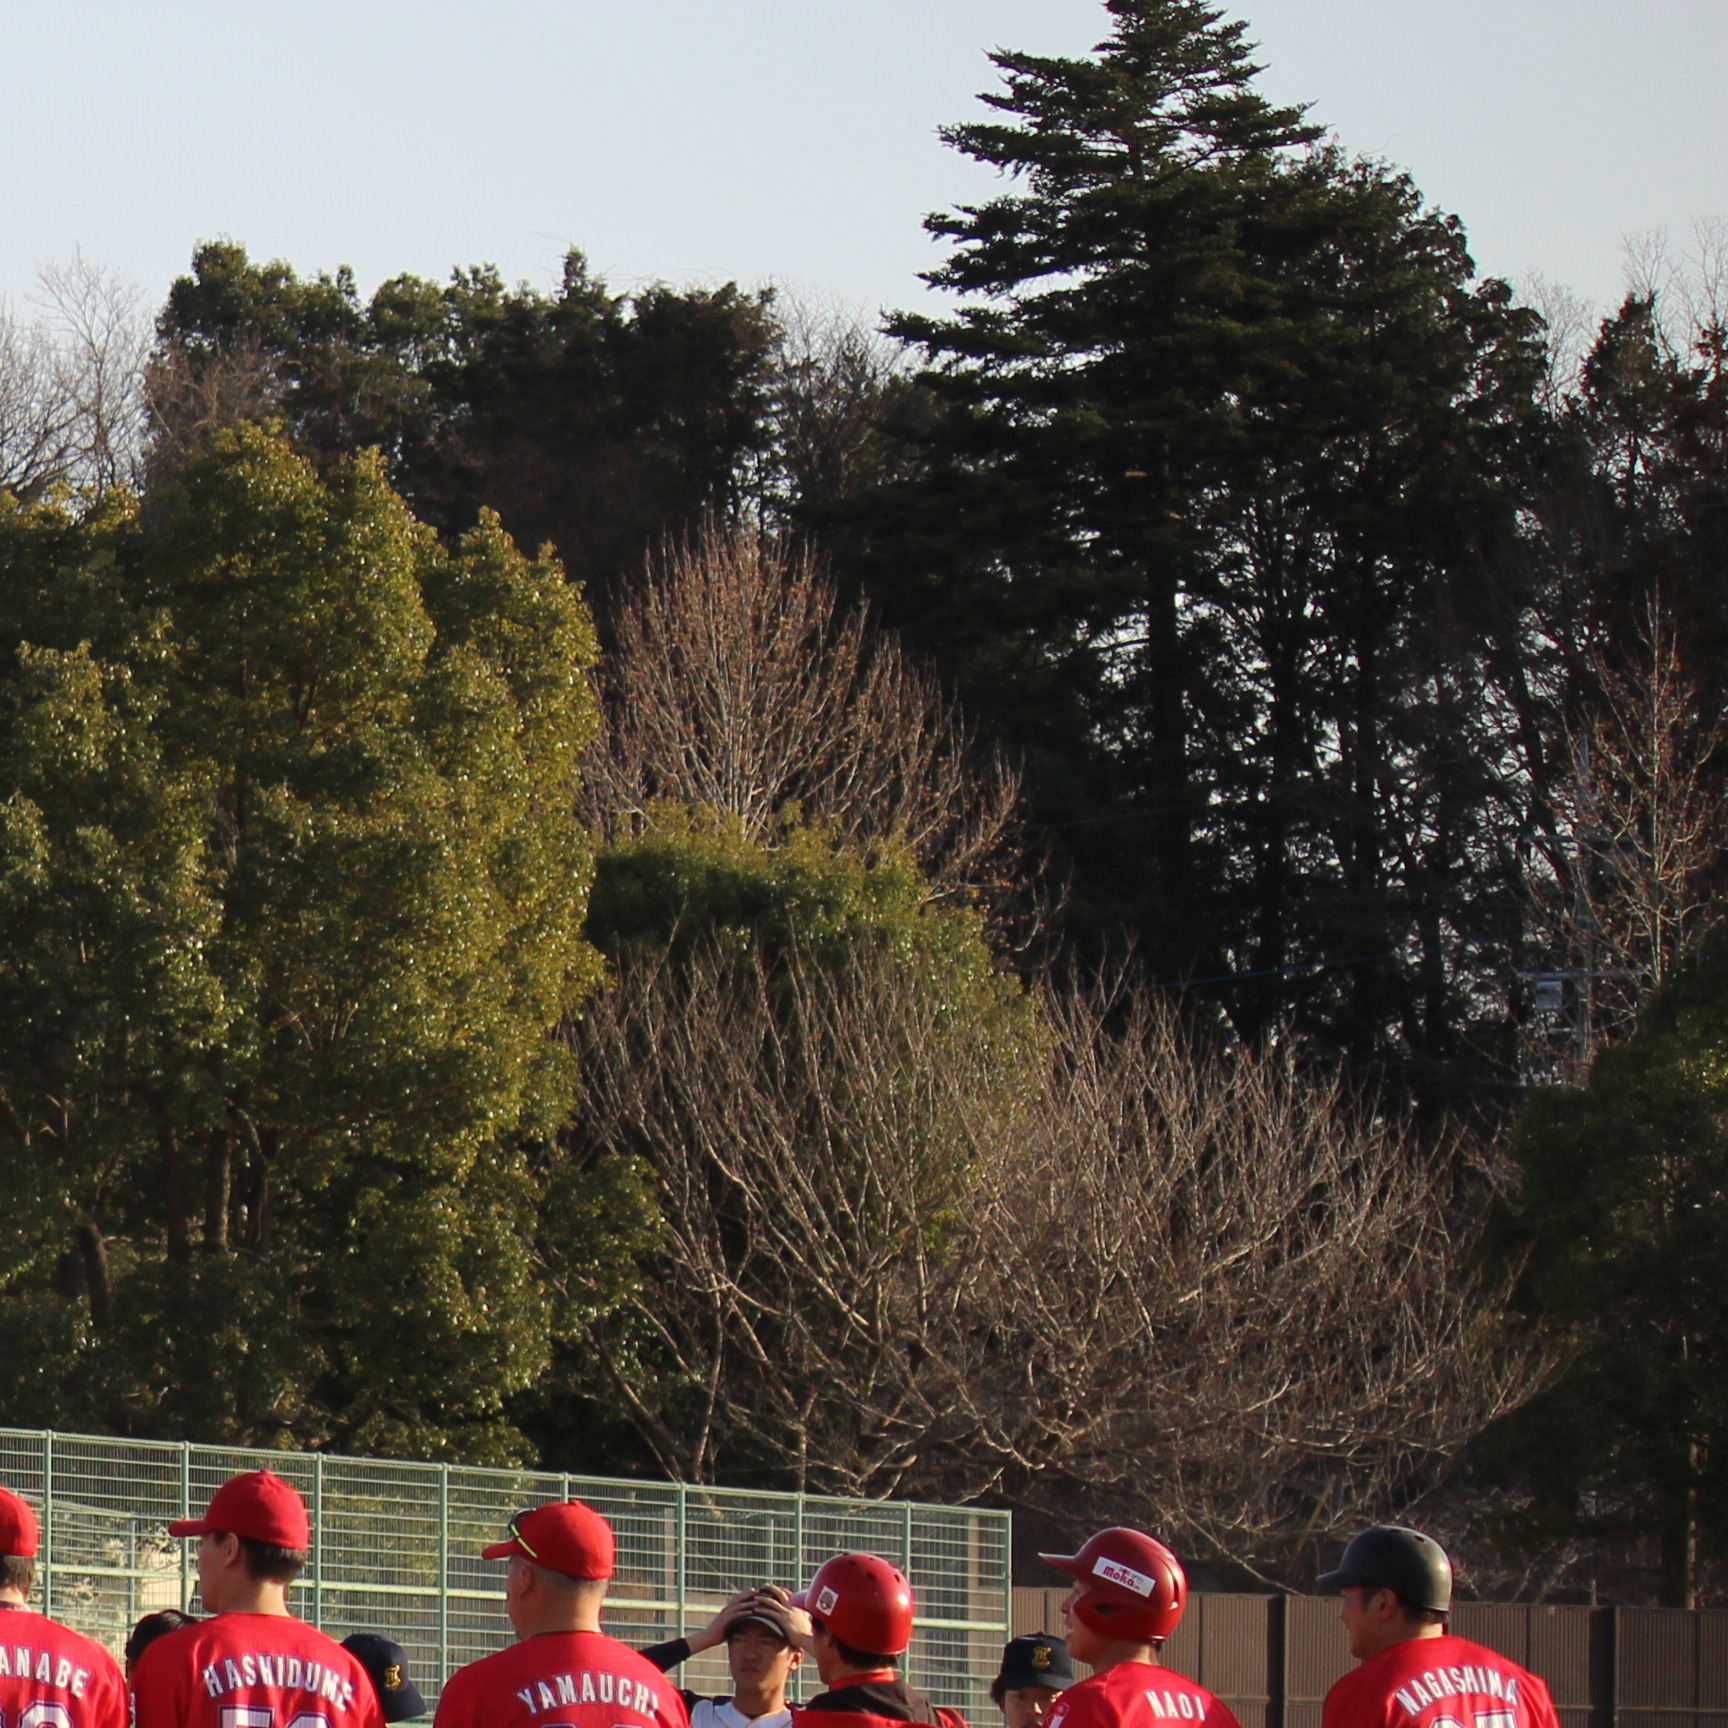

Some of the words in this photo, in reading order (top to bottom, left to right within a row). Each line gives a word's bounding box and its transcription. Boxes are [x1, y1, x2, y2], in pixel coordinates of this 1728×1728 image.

[202, 1655, 354, 1713] HASHIDUME
[513, 1672, 662, 1719] YAMAUCHI
[1144, 1690, 1207, 1722] NAOI
[1392, 1664, 1519, 1716] NAGASHIMA
